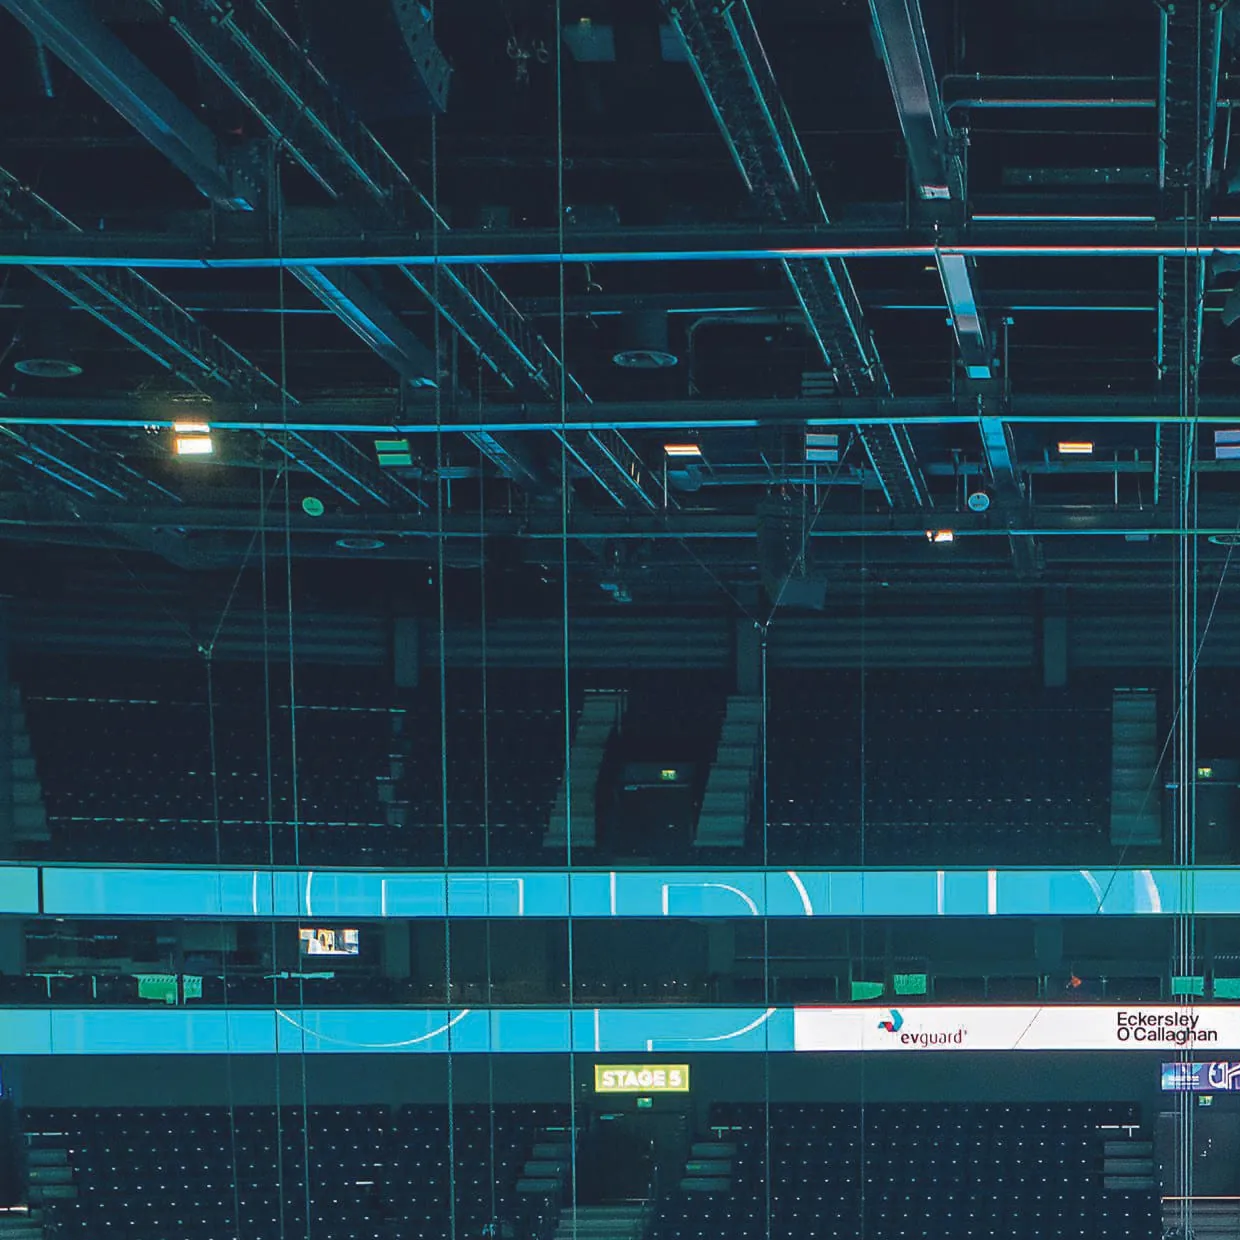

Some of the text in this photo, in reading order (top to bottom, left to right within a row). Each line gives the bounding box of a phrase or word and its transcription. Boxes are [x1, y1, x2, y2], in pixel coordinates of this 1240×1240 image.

[1116, 1012, 1200, 1028] Eckersley
[1116, 1026, 1218, 1045] O'Callaghan
[602, 1069, 682, 1088] STAGE 5
